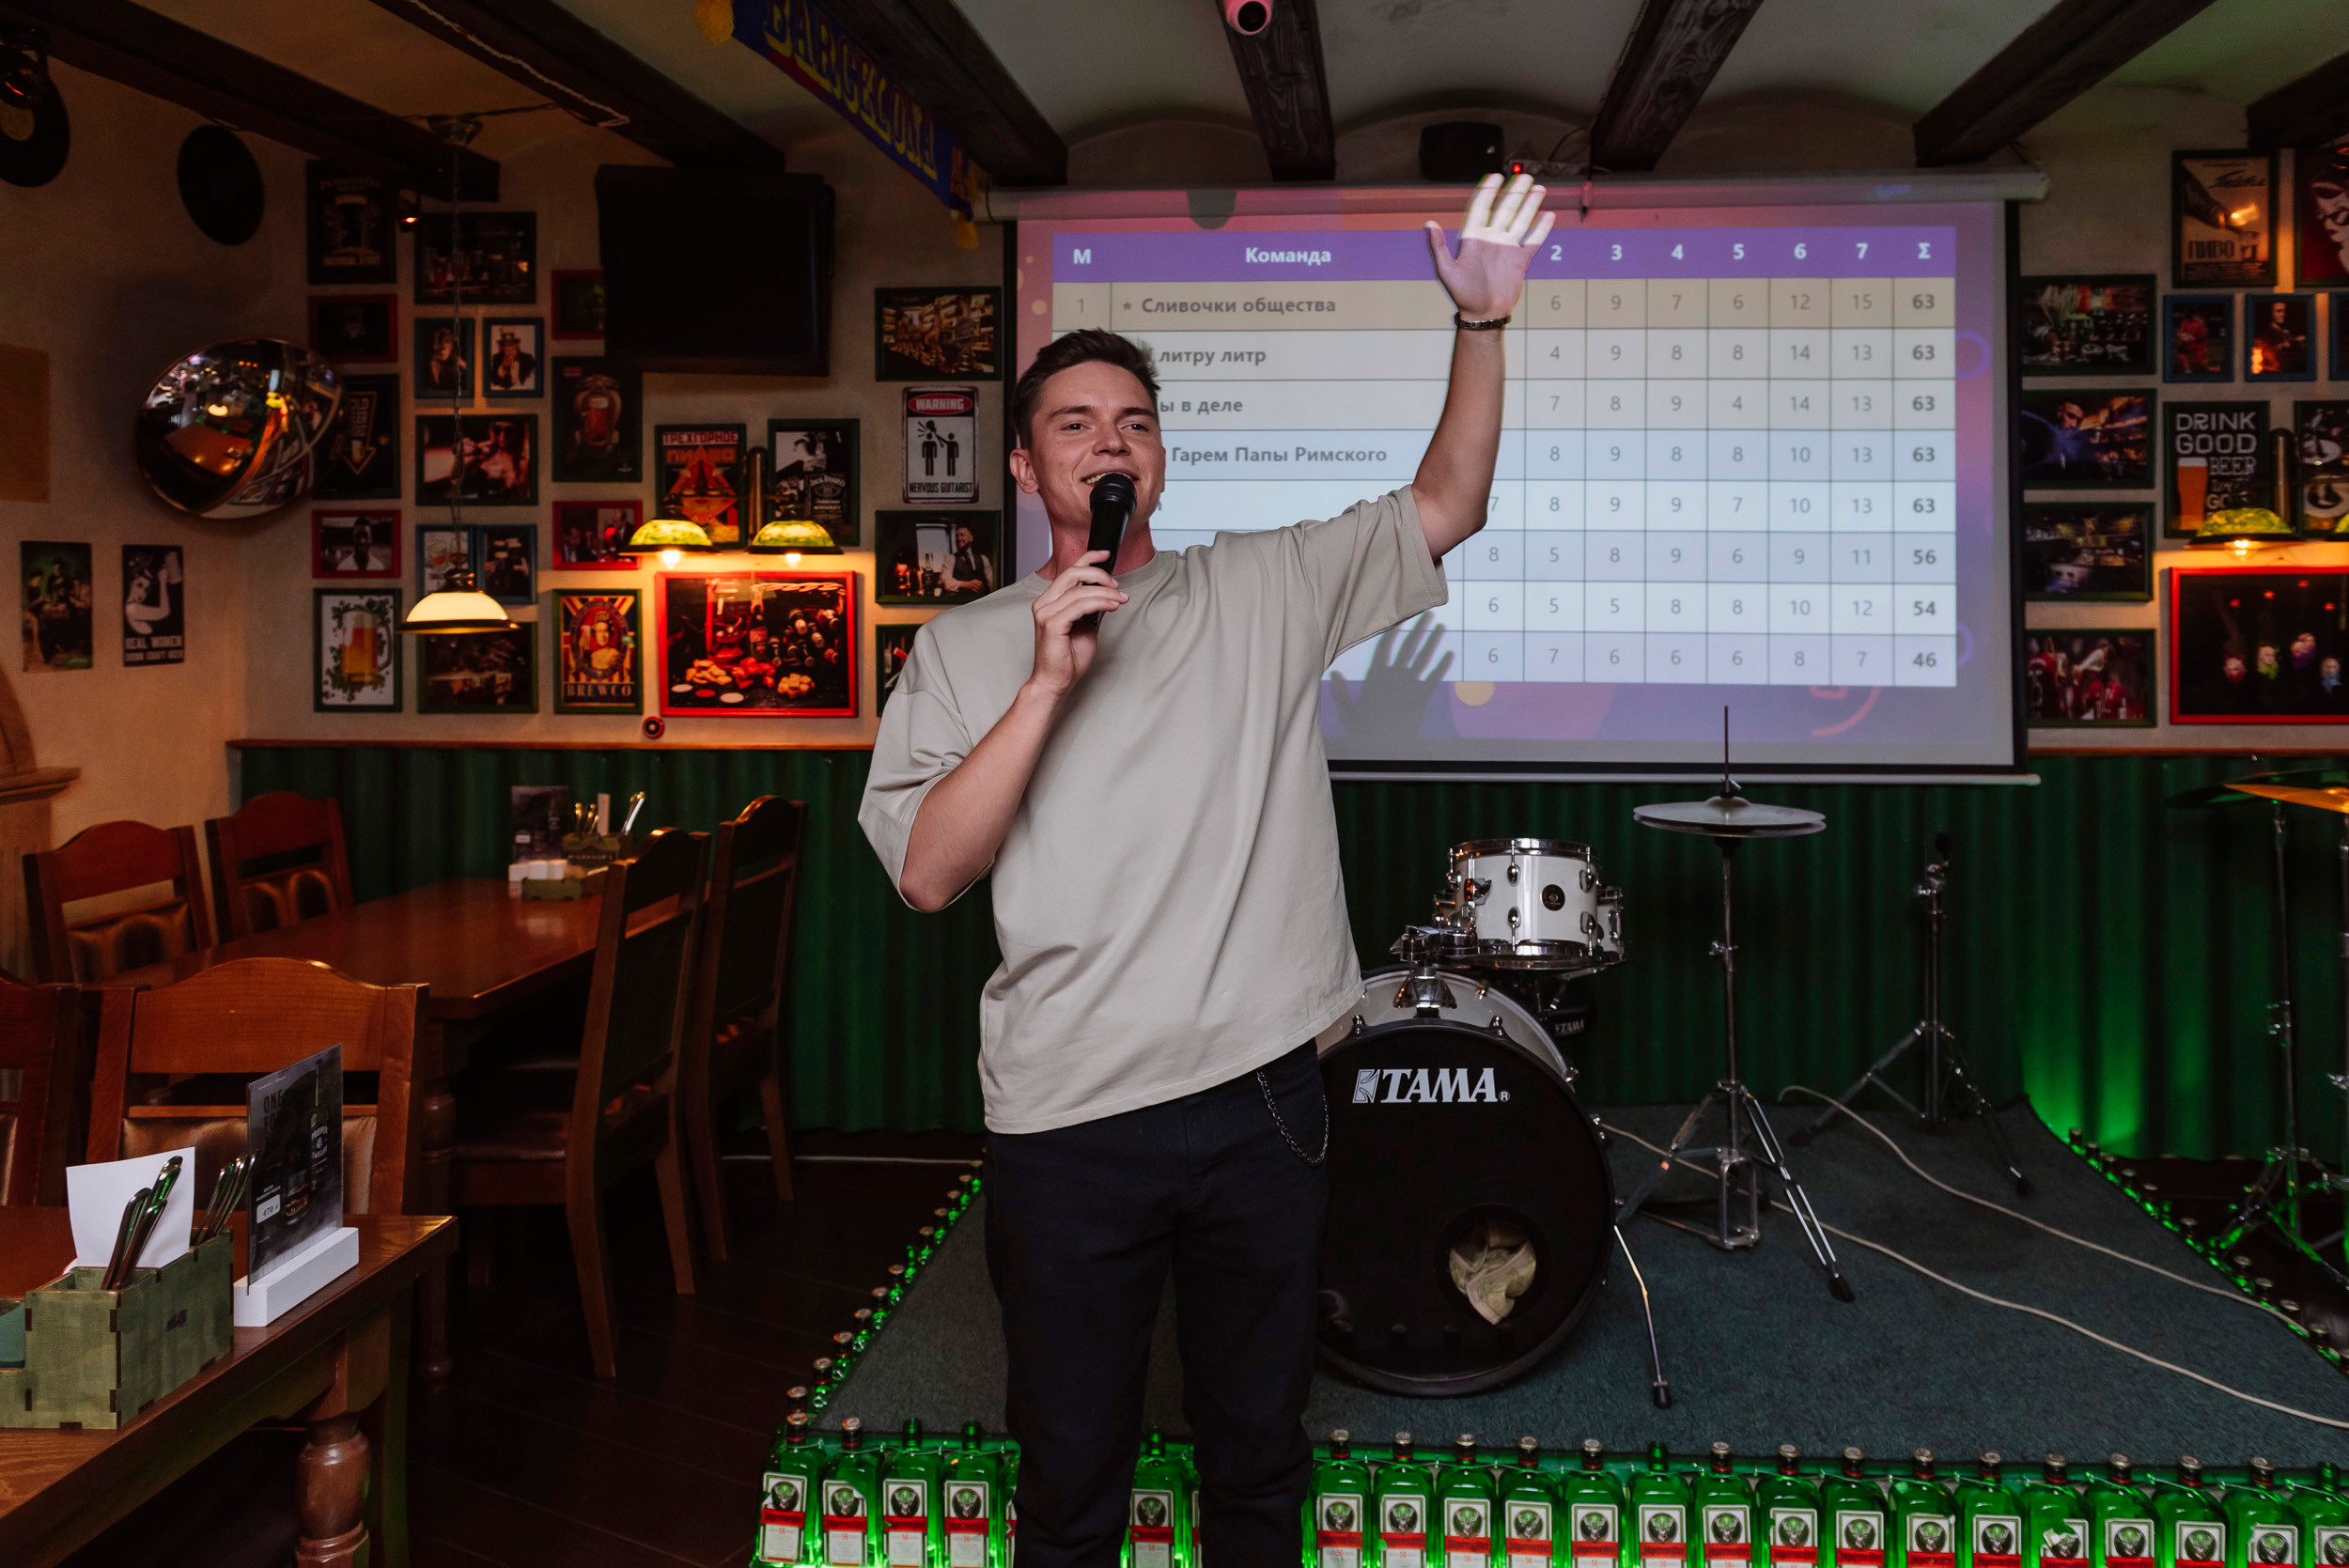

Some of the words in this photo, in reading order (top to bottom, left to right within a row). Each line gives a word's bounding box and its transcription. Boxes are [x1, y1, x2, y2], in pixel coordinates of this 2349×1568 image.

[1245, 246, 1331, 267] Команда
[1549, 244, 1563, 261] 2
[1610, 243, 1623, 261] 3
[1671, 243, 1685, 260] 4
[1733, 242, 1745, 260] 5
[1794, 242, 1808, 260] 6
[1856, 242, 1869, 259] 7
[1078, 298, 1084, 314] 1
[1142, 298, 1237, 314] Сливочки
[1242, 297, 1336, 316] общества
[1550, 294, 1562, 311] 6
[1610, 294, 1622, 311] 9
[1672, 294, 1683, 310] 7
[1733, 294, 1745, 310] 6
[1790, 293, 1811, 311] 12
[1852, 293, 1873, 310] 15
[1912, 293, 1936, 310] 63
[1158, 350, 1216, 366] литру
[1220, 350, 1267, 366] литр
[1549, 345, 1561, 361] 4
[1610, 345, 1622, 362] 9
[1671, 344, 1683, 362] 8
[1732, 344, 1744, 361] 8
[1790, 345, 1811, 361] 14
[1852, 344, 1873, 362] 13
[1912, 344, 1936, 361] 63
[915, 398, 965, 411] WARNING
[1159, 401, 1174, 412] ы
[1181, 400, 1191, 412] в
[1197, 400, 1243, 415] деле
[1549, 395, 1561, 411] 7
[1610, 395, 1622, 411] 8
[1671, 395, 1682, 411] 9
[1732, 396, 1743, 411] 4
[1790, 396, 1811, 411] 14
[1852, 396, 1873, 412] 13
[1912, 395, 1936, 411] 63
[2176, 411, 2257, 431] DRINK
[2175, 433, 2257, 455] GOOD
[1172, 446, 1228, 465] Гарем
[1235, 446, 1288, 462] Папы
[1295, 446, 1387, 462] Римского
[1549, 445, 1561, 462] 8
[1610, 445, 1621, 462] 9
[1671, 445, 1683, 462] 8
[1732, 445, 1744, 462] 8
[1790, 446, 1812, 463] 10
[1852, 446, 1873, 463] 13
[1912, 446, 1936, 463] 63
[2208, 456, 2257, 476] BEER
[909, 481, 940, 494] NERVOUS
[941, 481, 973, 494] GUITARIST
[1488, 496, 1500, 512] 7
[1548, 496, 1561, 512] 8
[1610, 496, 1621, 513] 9
[1671, 496, 1682, 513] 9
[1733, 496, 1743, 513] 7
[1790, 497, 1812, 514] 10
[1852, 497, 1873, 515] 13
[1912, 498, 1936, 514] 63
[1488, 546, 1500, 563] 8
[1549, 547, 1560, 563] 5
[1609, 547, 1621, 564] 8
[1671, 547, 1682, 564] 9
[1732, 548, 1744, 565] 6
[1794, 548, 1806, 565] 9
[1852, 549, 1871, 565] 11
[1913, 549, 1937, 566] 56
[1488, 597, 1500, 613] 6
[1549, 597, 1560, 613] 5
[1610, 598, 1620, 614] 5
[1670, 598, 1682, 614] 8
[1732, 598, 1743, 615] 8
[1790, 599, 1812, 616] 10
[1852, 599, 1873, 616] 12
[1913, 600, 1937, 616] 54
[1487, 647, 1499, 664] 6
[1548, 647, 1559, 664] 7
[1609, 648, 1620, 665] 6
[1670, 649, 1682, 665] 6
[1732, 649, 1743, 666] 6
[1794, 650, 1806, 667] 8
[1857, 650, 1868, 667] 7
[1912, 652, 1937, 668] 46
[567, 684, 632, 697] BREWCO
[1380, 1067, 1499, 1104] TAMA
[263, 1089, 284, 1114] ONE
[311, 1126, 328, 1141] PROPER
[263, 1205, 274, 1217] 470
